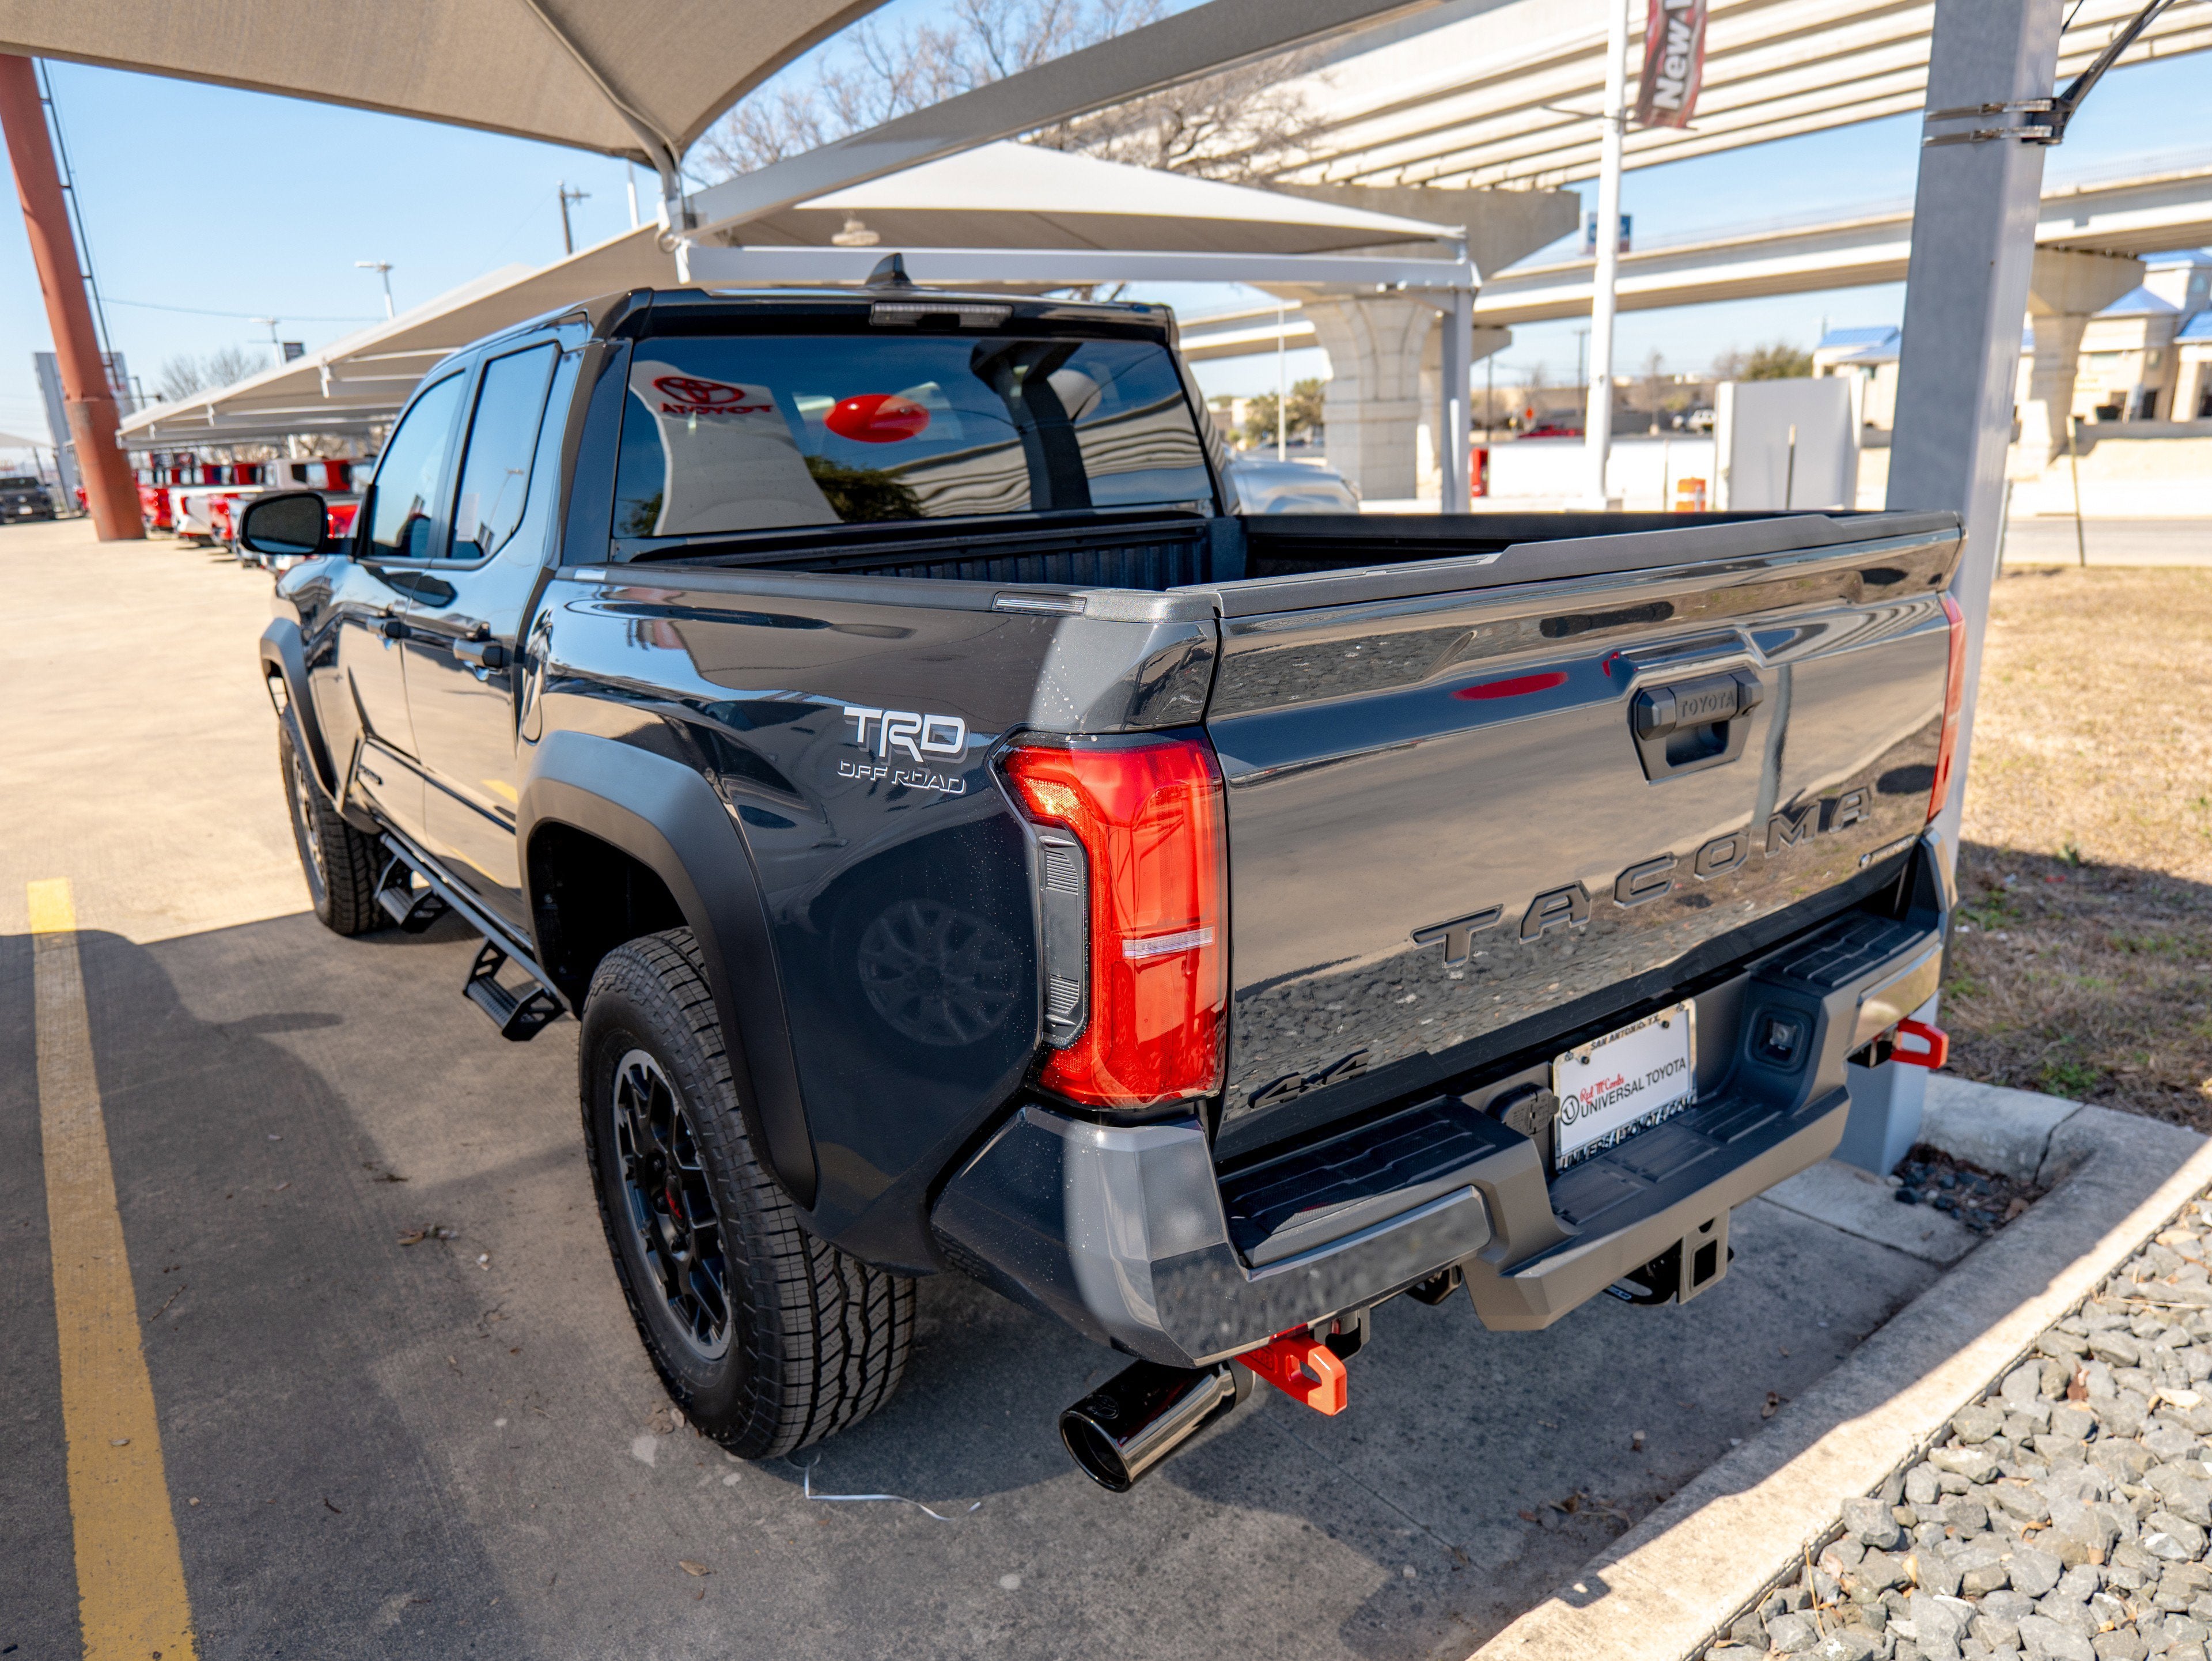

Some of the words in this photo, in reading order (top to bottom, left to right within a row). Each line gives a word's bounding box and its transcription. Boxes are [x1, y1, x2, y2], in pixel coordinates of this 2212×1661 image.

[1653, 17, 1692, 109] New
[1682, 693, 1735, 717] TOYOTA
[844, 706, 965, 763] TRD
[838, 760, 888, 781] OFF
[891, 770, 966, 794] ROAD
[1409, 786, 1872, 968] TACOMA
[1590, 1037, 1607, 1050] SAN
[1648, 1015, 1660, 1026] TX
[1580, 1085, 1593, 1104] Red
[1581, 1078, 1645, 1117] UNIVERSAL
[1646, 1057, 1685, 1087] TOYOTA
